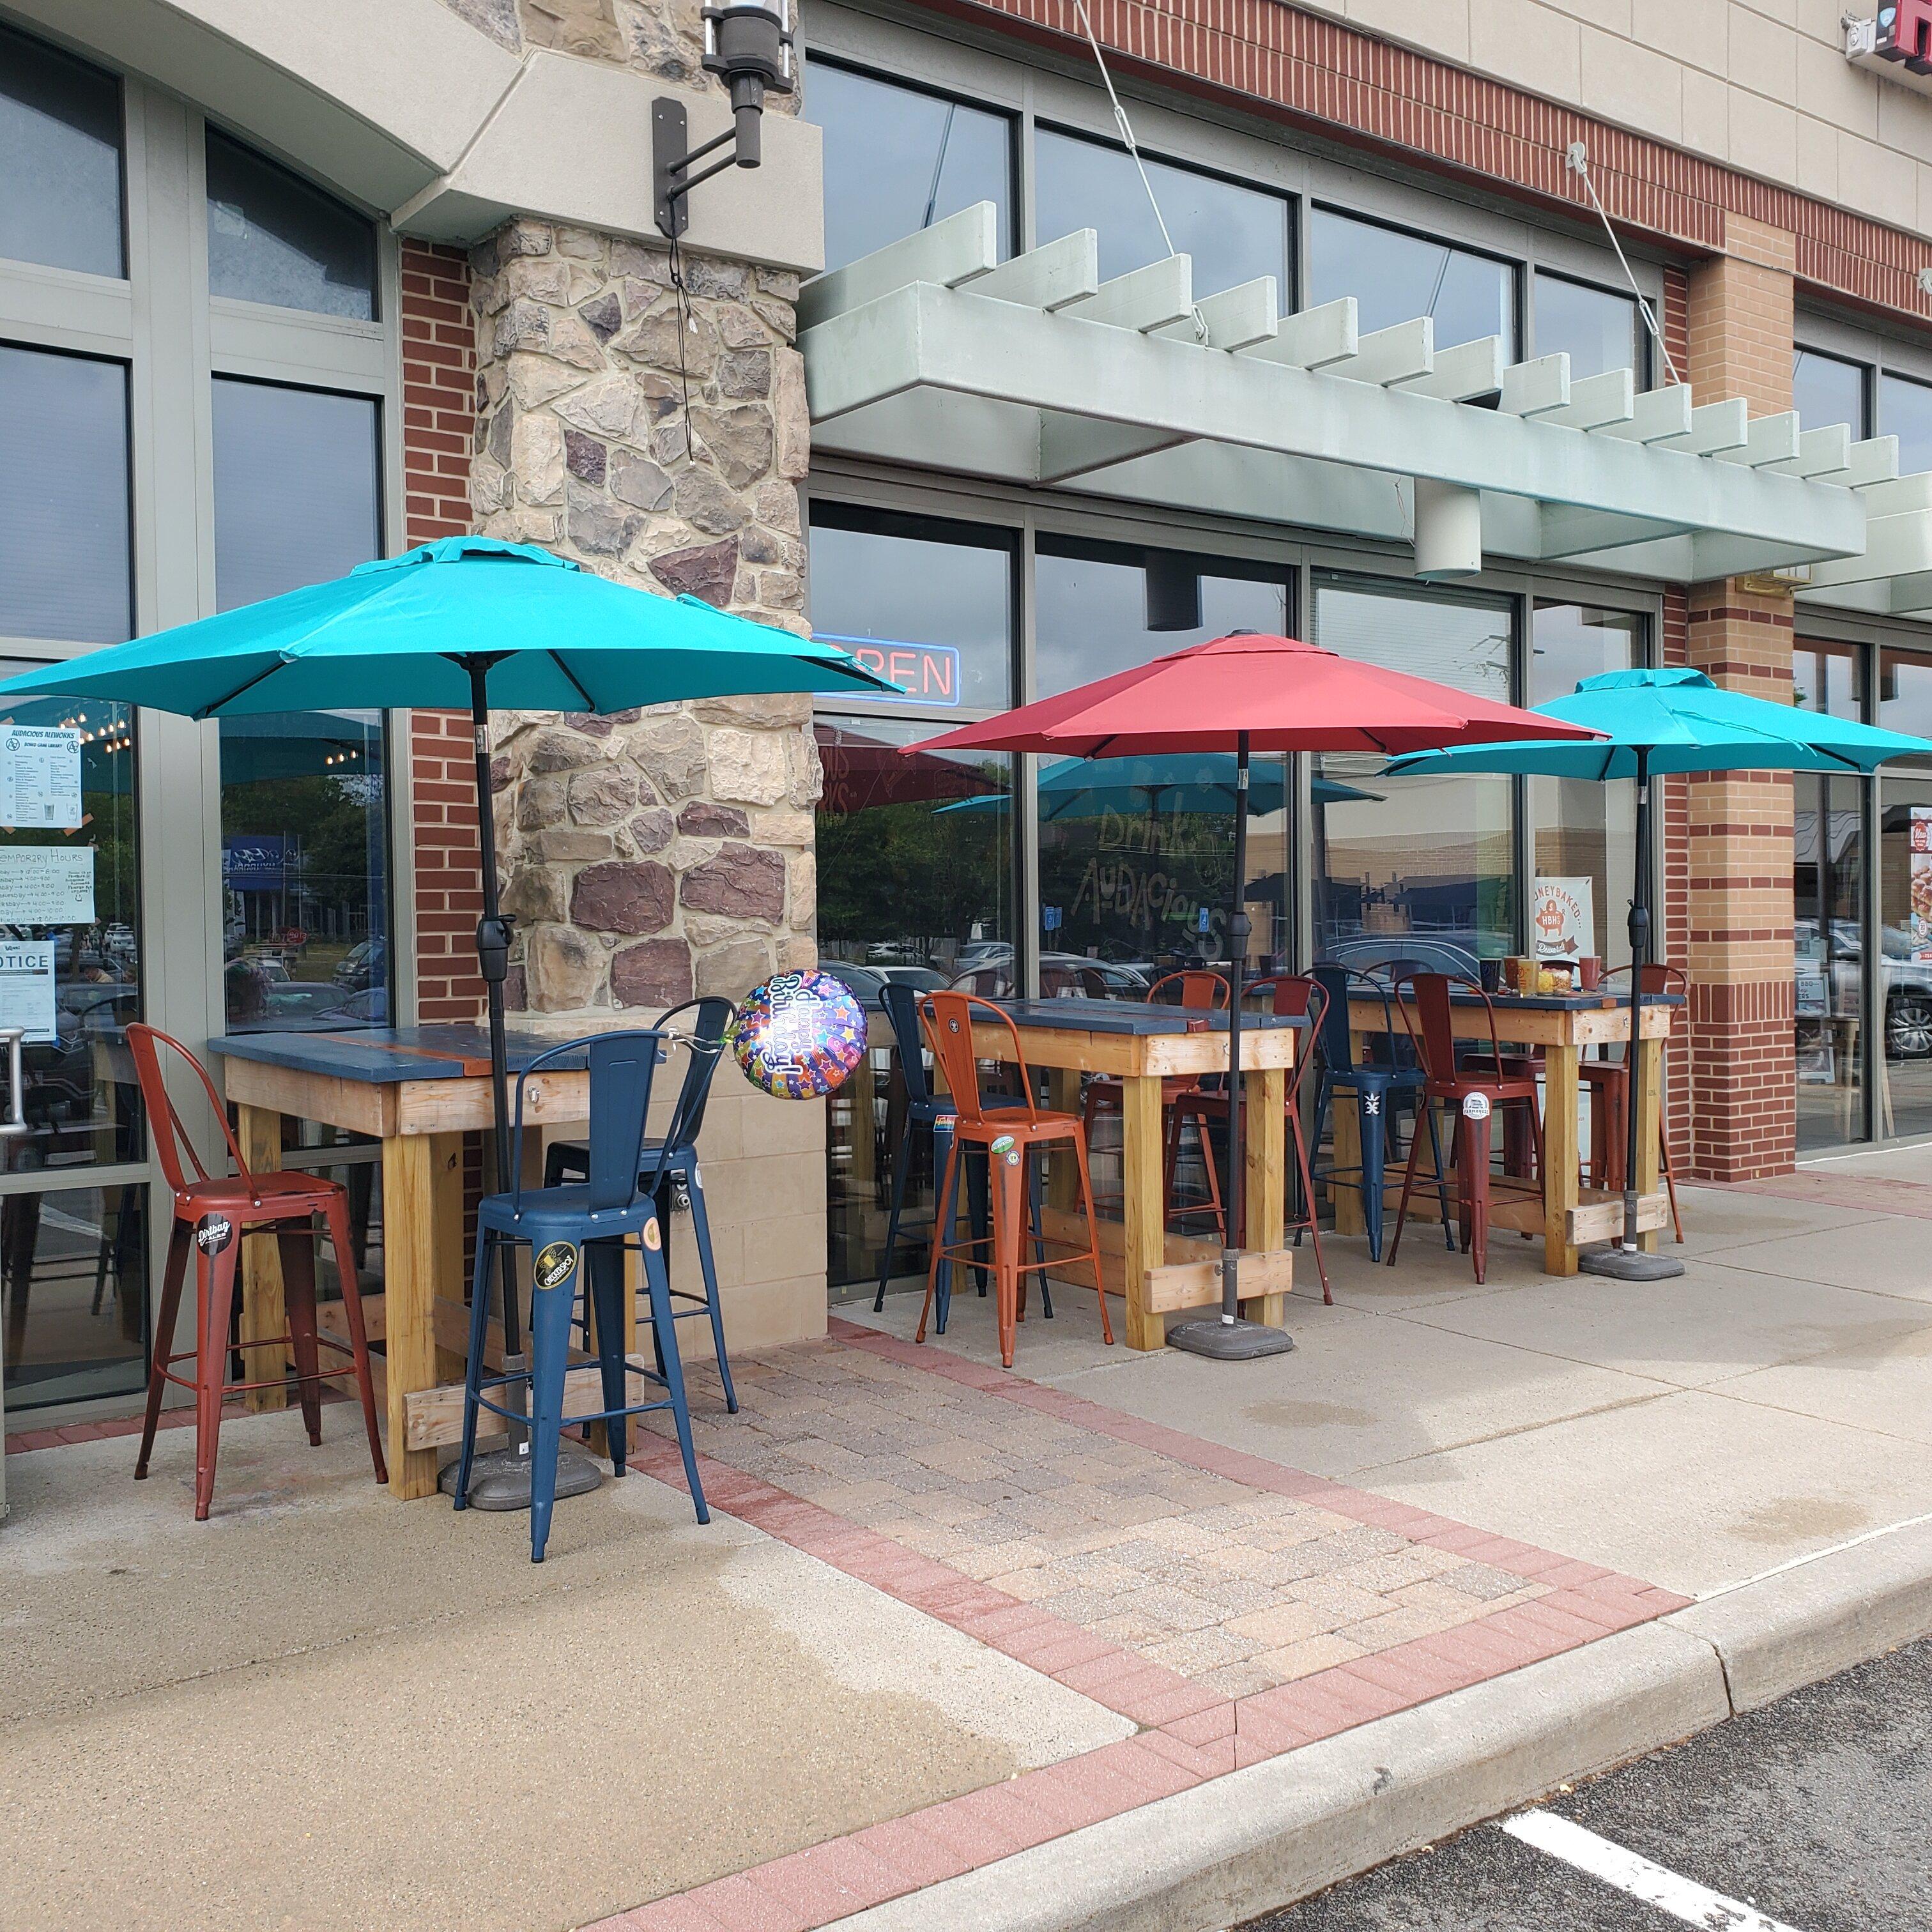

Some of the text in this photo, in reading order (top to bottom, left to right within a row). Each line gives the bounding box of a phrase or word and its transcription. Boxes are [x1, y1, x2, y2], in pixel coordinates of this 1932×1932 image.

[831, 644, 951, 695] PEN
[12, 730, 44, 738] AUDACIOUS
[1537, 941, 1565, 954] Rewards
[790, 991, 820, 1054] Happy
[198, 1221, 231, 1246] Dirtbag
[544, 1254, 574, 1286] CHECKERSPOT
